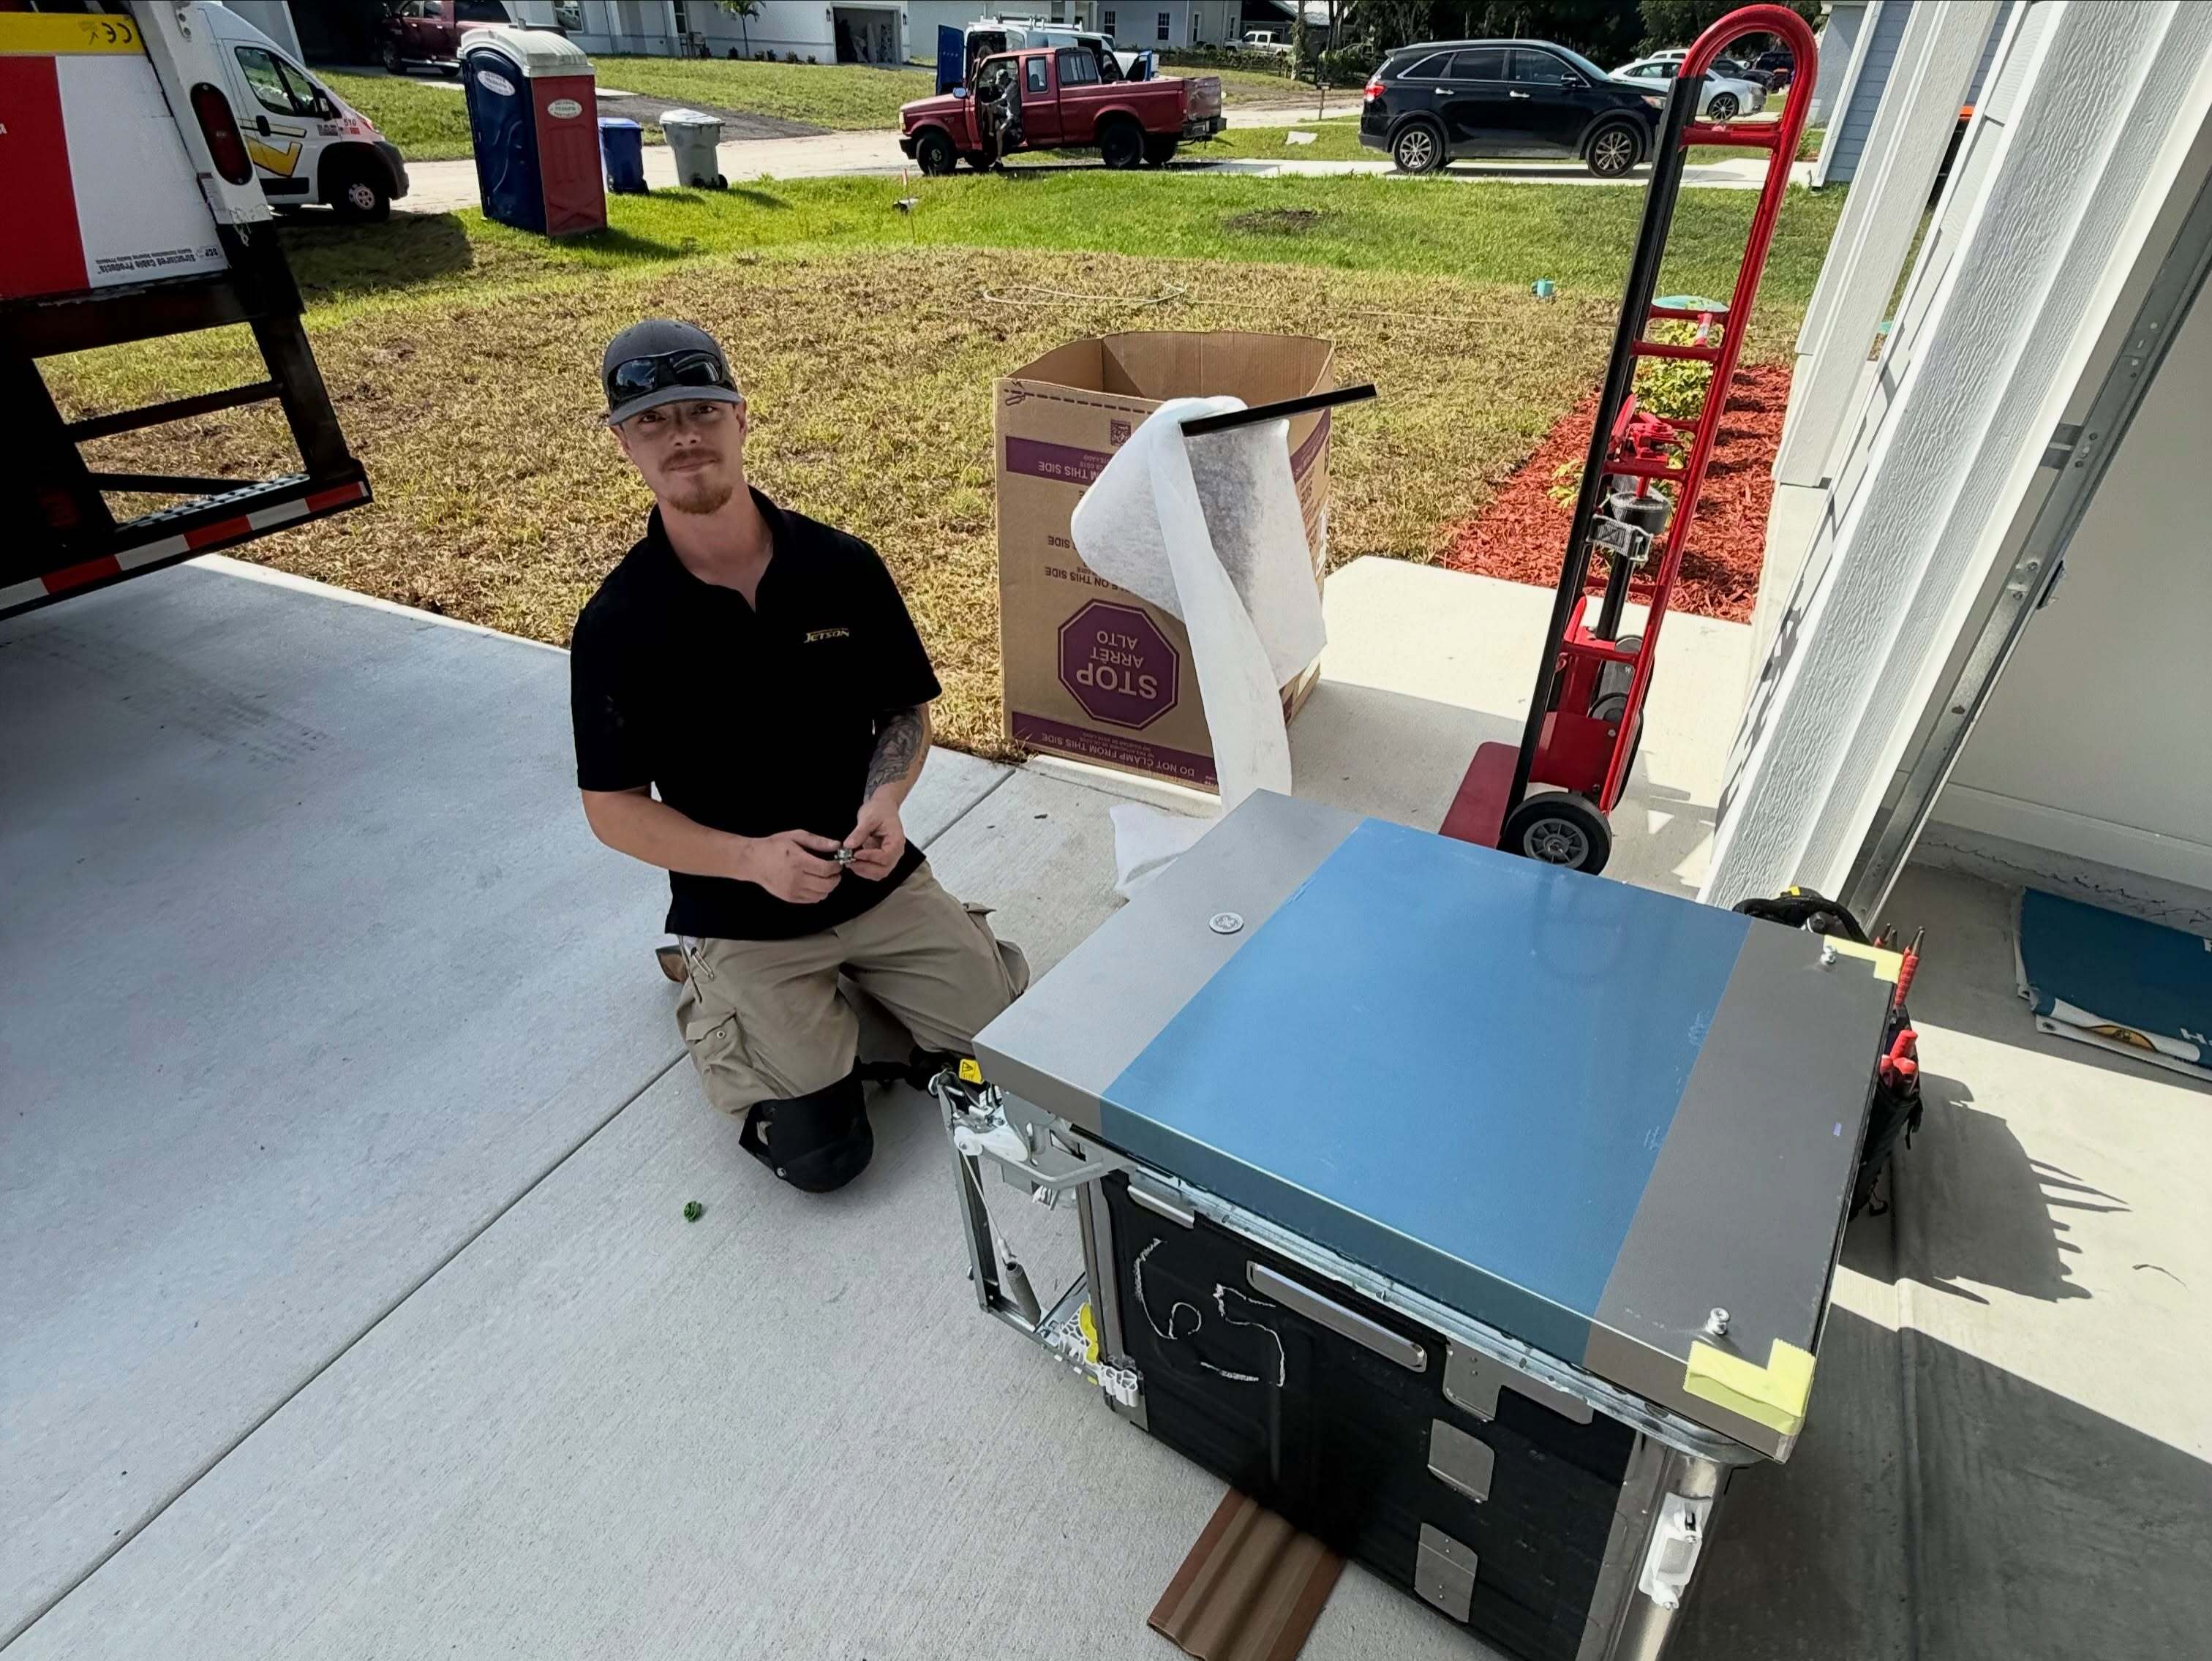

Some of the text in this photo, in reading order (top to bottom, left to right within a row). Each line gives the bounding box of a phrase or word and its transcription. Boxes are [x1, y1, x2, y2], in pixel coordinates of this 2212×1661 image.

[1038, 461, 1062, 475] SIDE
[1064, 466, 1088, 480] THIS
[1047, 535, 1071, 549] SIDE
[1045, 566, 1068, 579] SIDE
[1069, 571, 1092, 584] THIS
[1094, 577, 1110, 588] ON
[1096, 630, 1138, 650] ALTO
[1090, 647, 1144, 668] ARRÊT
[1076, 662, 1158, 700] STOP
[1041, 732, 1063, 745] SIDE
[1065, 738, 1087, 750] THIS
[1089, 745, 1117, 758] FROM
[1119, 752, 1154, 767] CLAMP
[1156, 760, 1177, 772] NOT
[1179, 766, 1195, 777] DO
